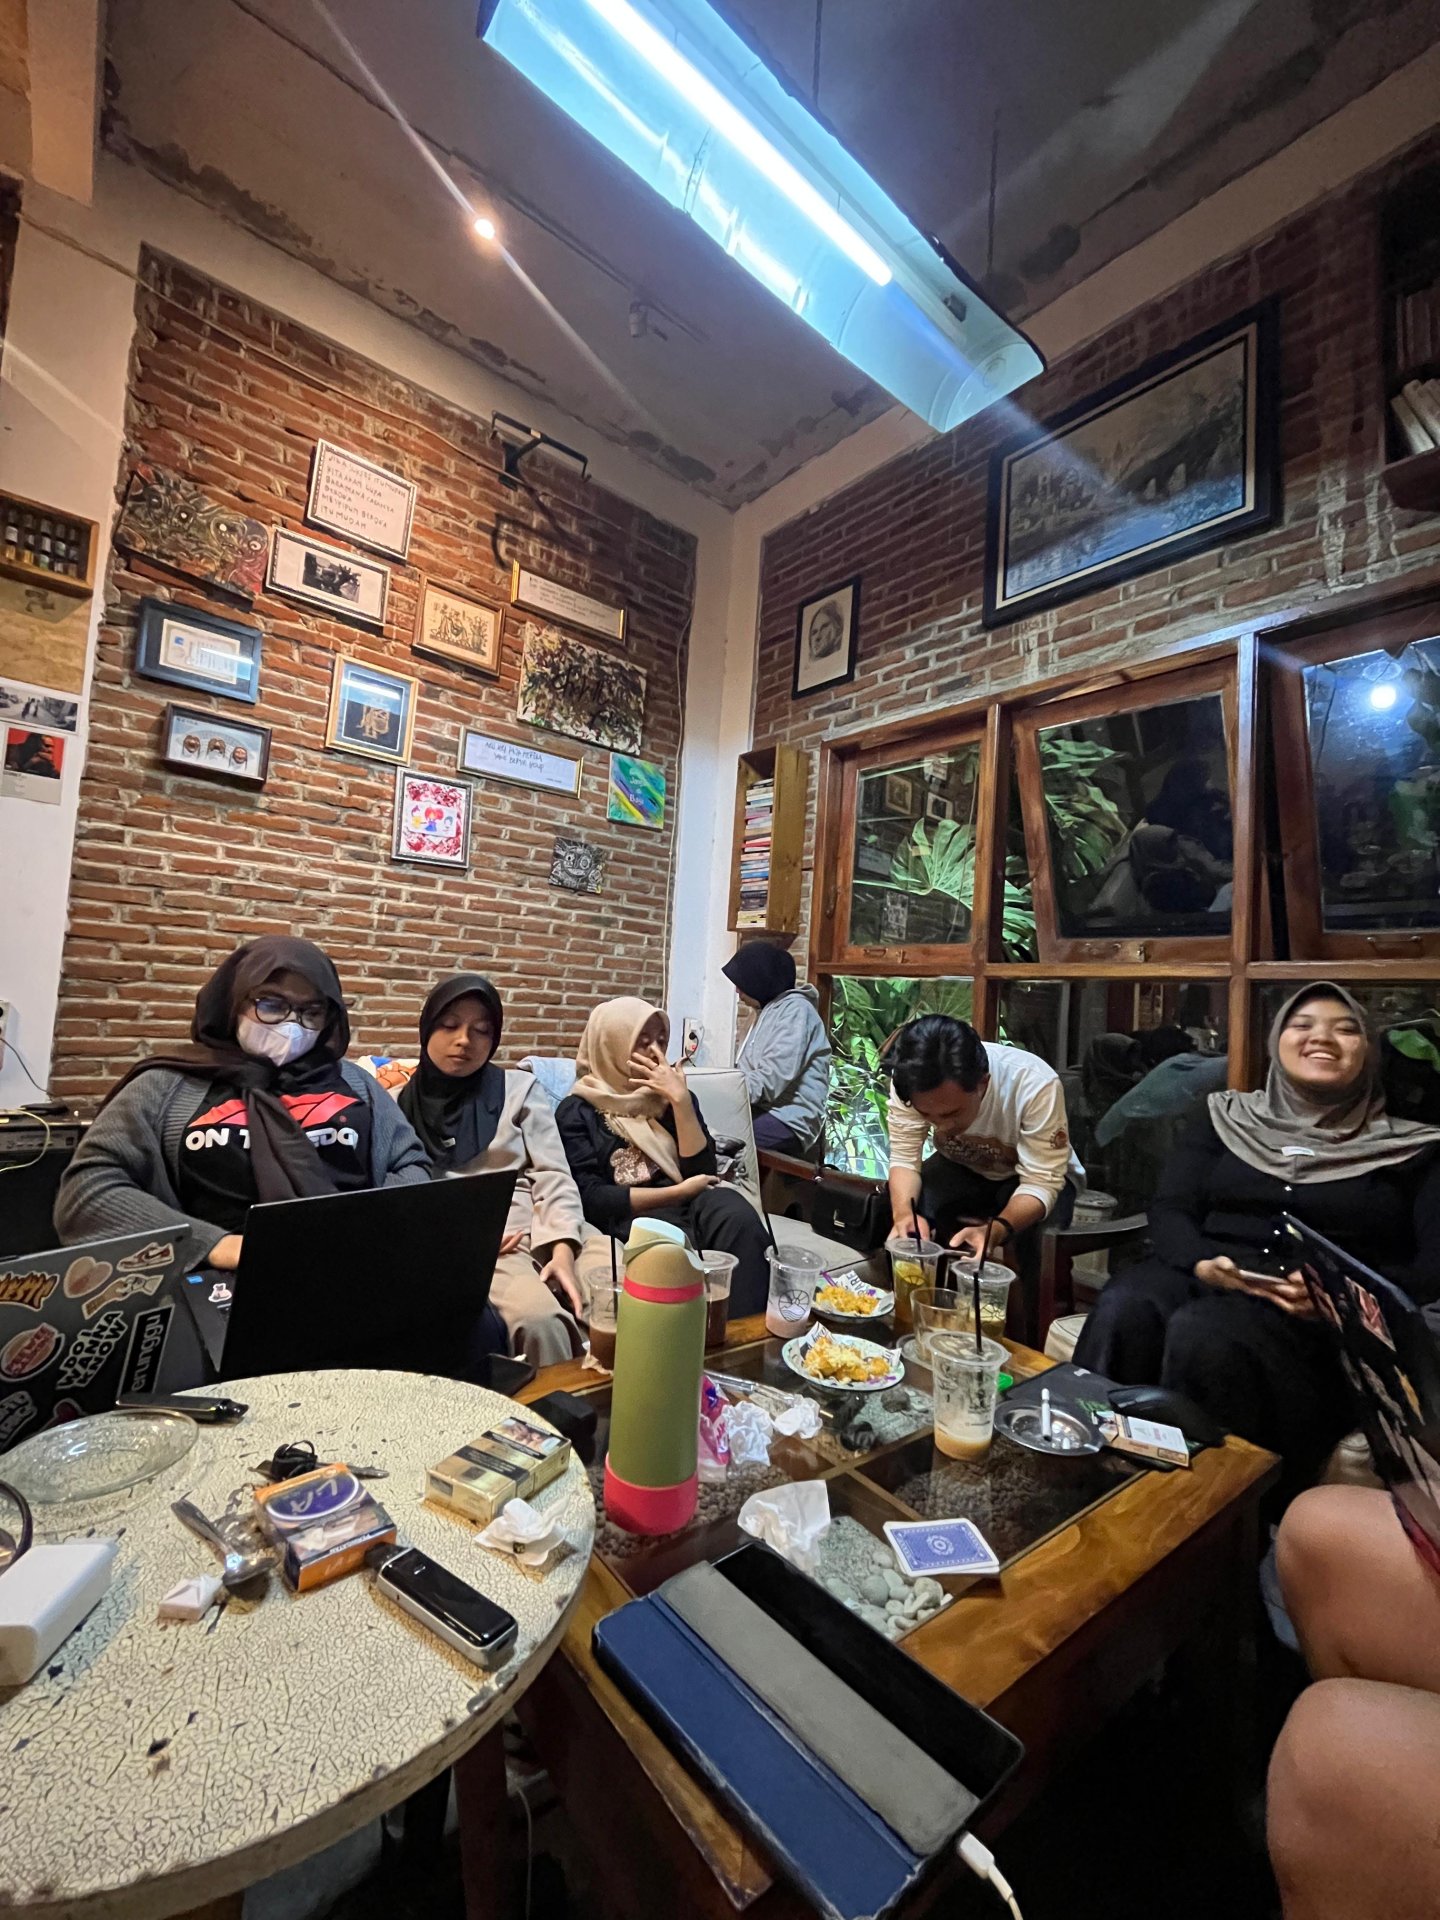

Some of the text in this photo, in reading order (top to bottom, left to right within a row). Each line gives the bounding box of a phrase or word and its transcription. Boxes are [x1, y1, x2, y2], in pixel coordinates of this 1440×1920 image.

[185, 1127, 230, 1150] ON
[59, 1313, 122, 1386] WANNA
[77, 1319, 127, 1385] KNOW
[131, 1313, 164, 1392] erunggu
[290, 1479, 338, 1514] LA
